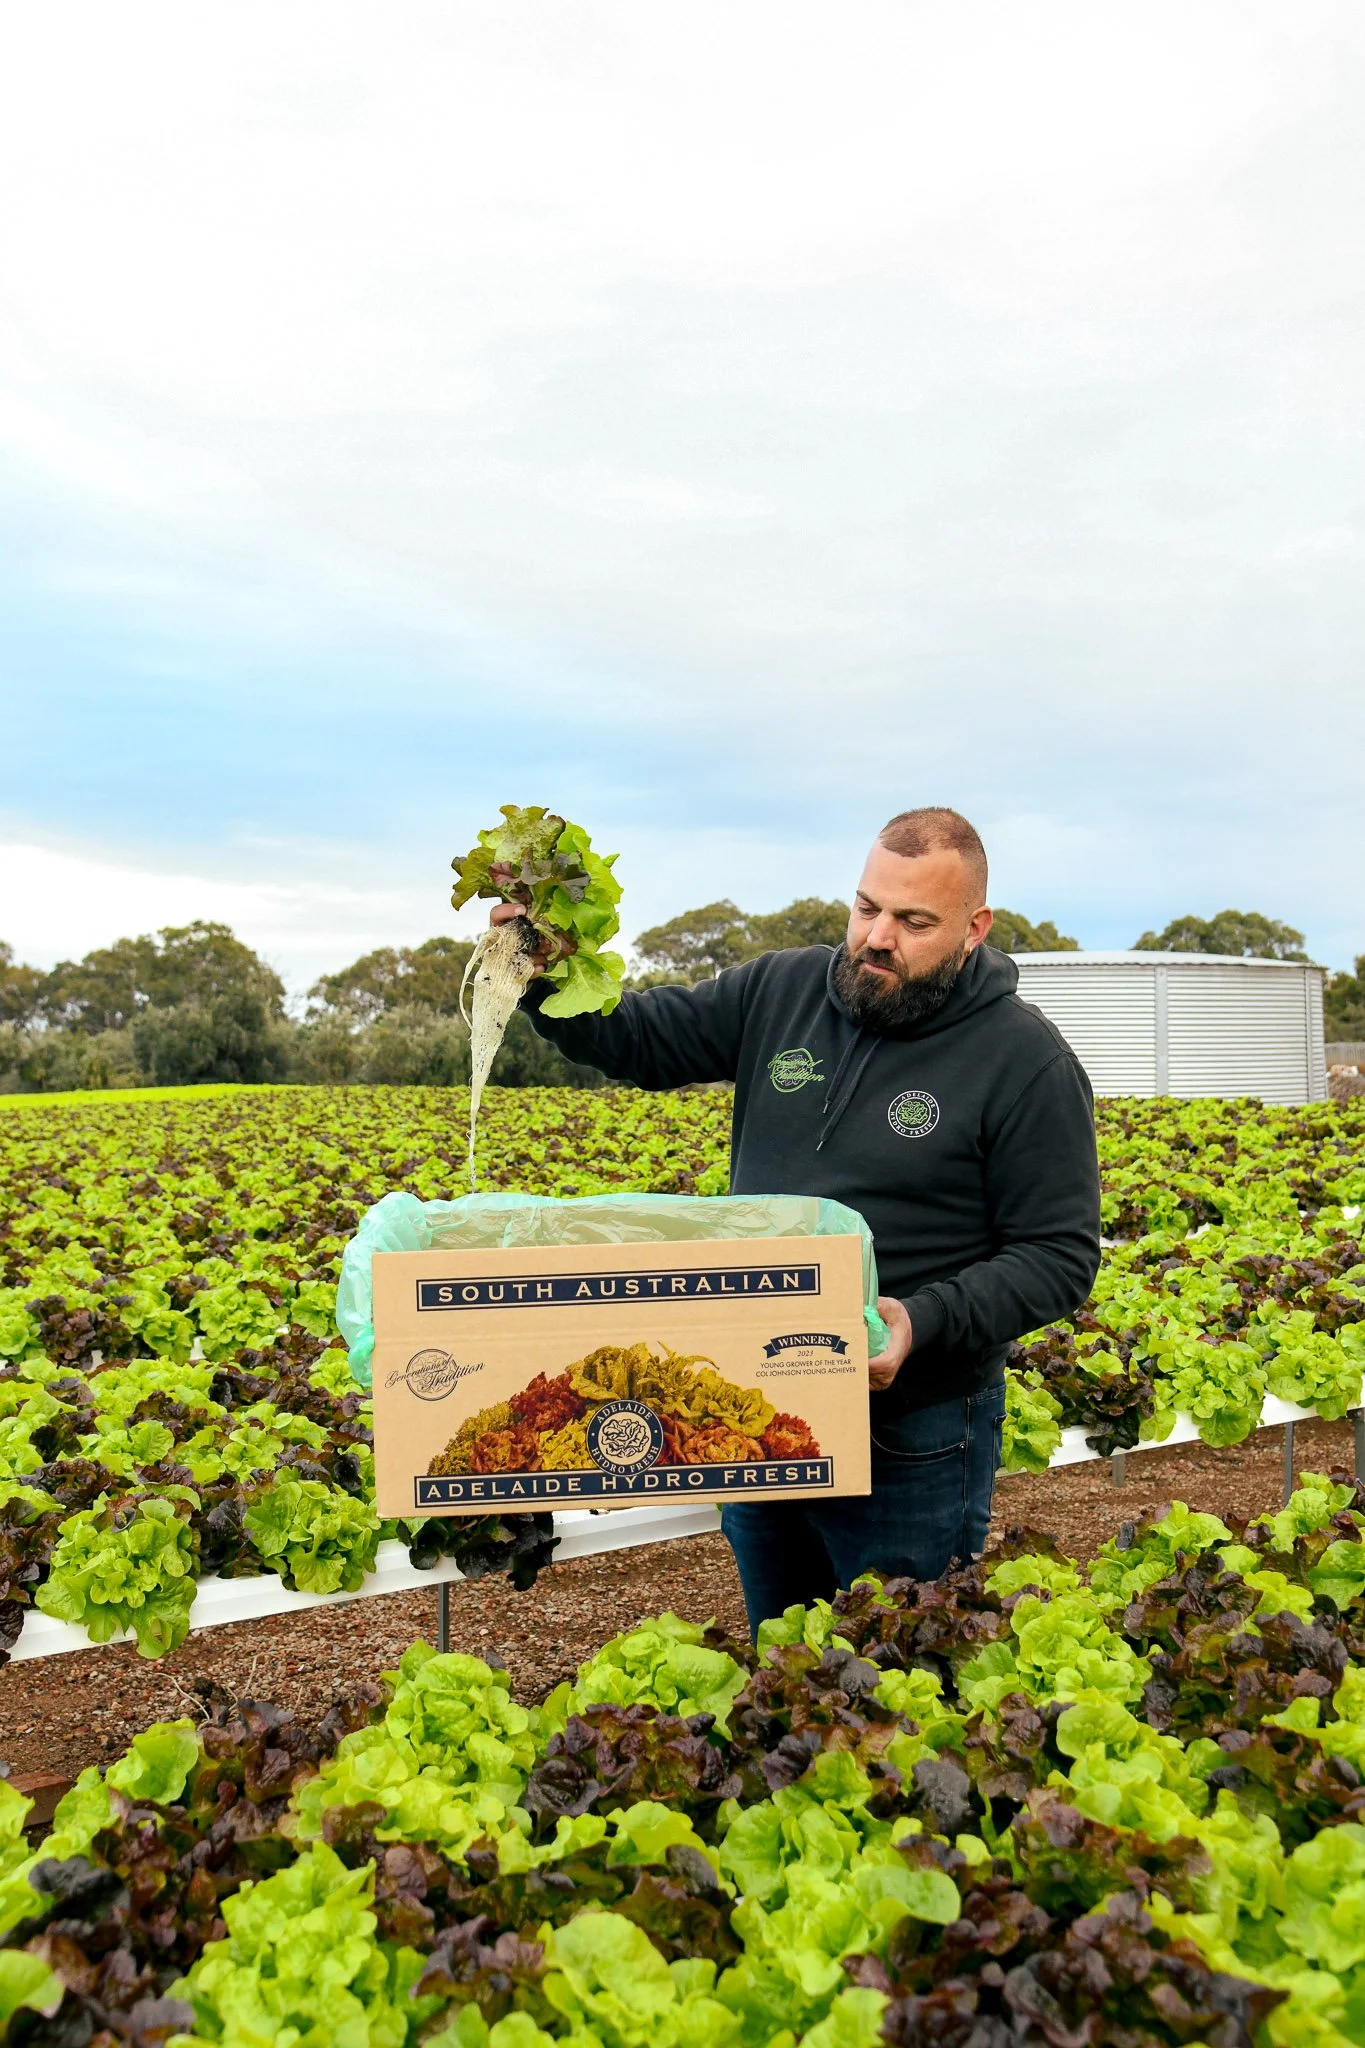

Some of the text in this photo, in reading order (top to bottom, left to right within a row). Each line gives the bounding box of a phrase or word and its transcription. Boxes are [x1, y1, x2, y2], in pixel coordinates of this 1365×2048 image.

[901, 1093, 935, 1108] ADELAIDE
[910, 1122, 933, 1135] FRESH
[438, 1272, 799, 1303] SOUTH AUSTRALIAN
[777, 1335, 833, 1347] WINNERS
[755, 1370, 768, 1378] COL
[769, 1369, 802, 1377] JOHNSON
[760, 1361, 785, 1369] YOUNG
[785, 1360, 813, 1368] GROWER
[421, 1362, 485, 1391] Tradition
[597, 1402, 653, 1423] ADELAIDE
[591, 1446, 659, 1474] HYDRO FRESH
[426, 1465, 821, 1499] ADELAIDE HYDRO FRESH
